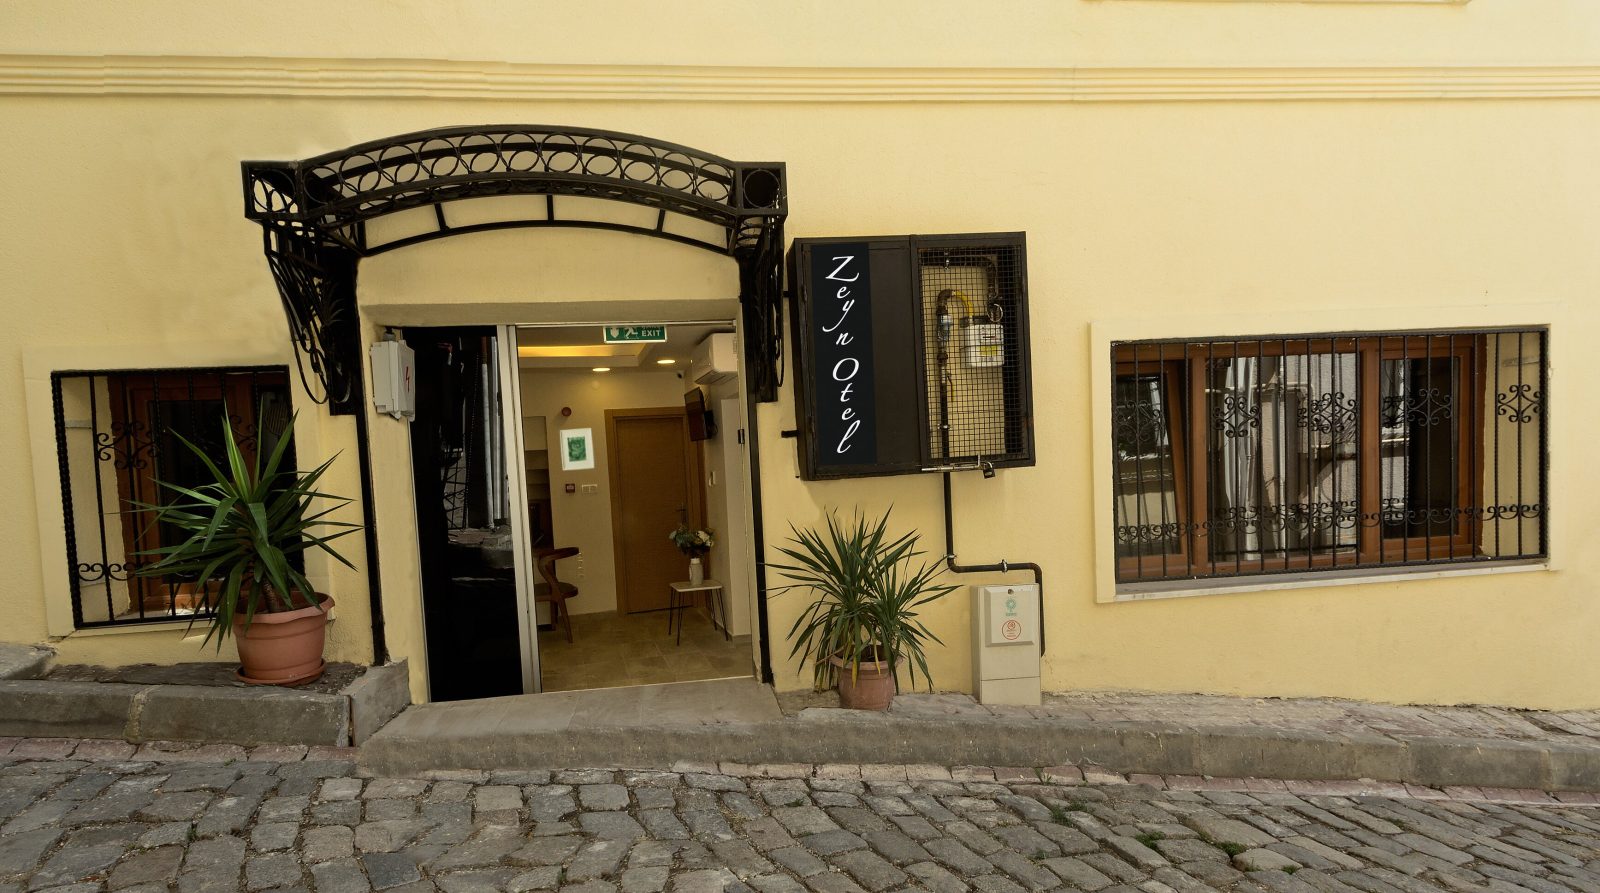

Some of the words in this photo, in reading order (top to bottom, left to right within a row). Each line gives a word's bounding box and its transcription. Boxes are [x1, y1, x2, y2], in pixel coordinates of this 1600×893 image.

[641, 329, 661, 337] EXIT
[822, 255, 860, 346] Zeyn
[832, 357, 861, 454] Otel
